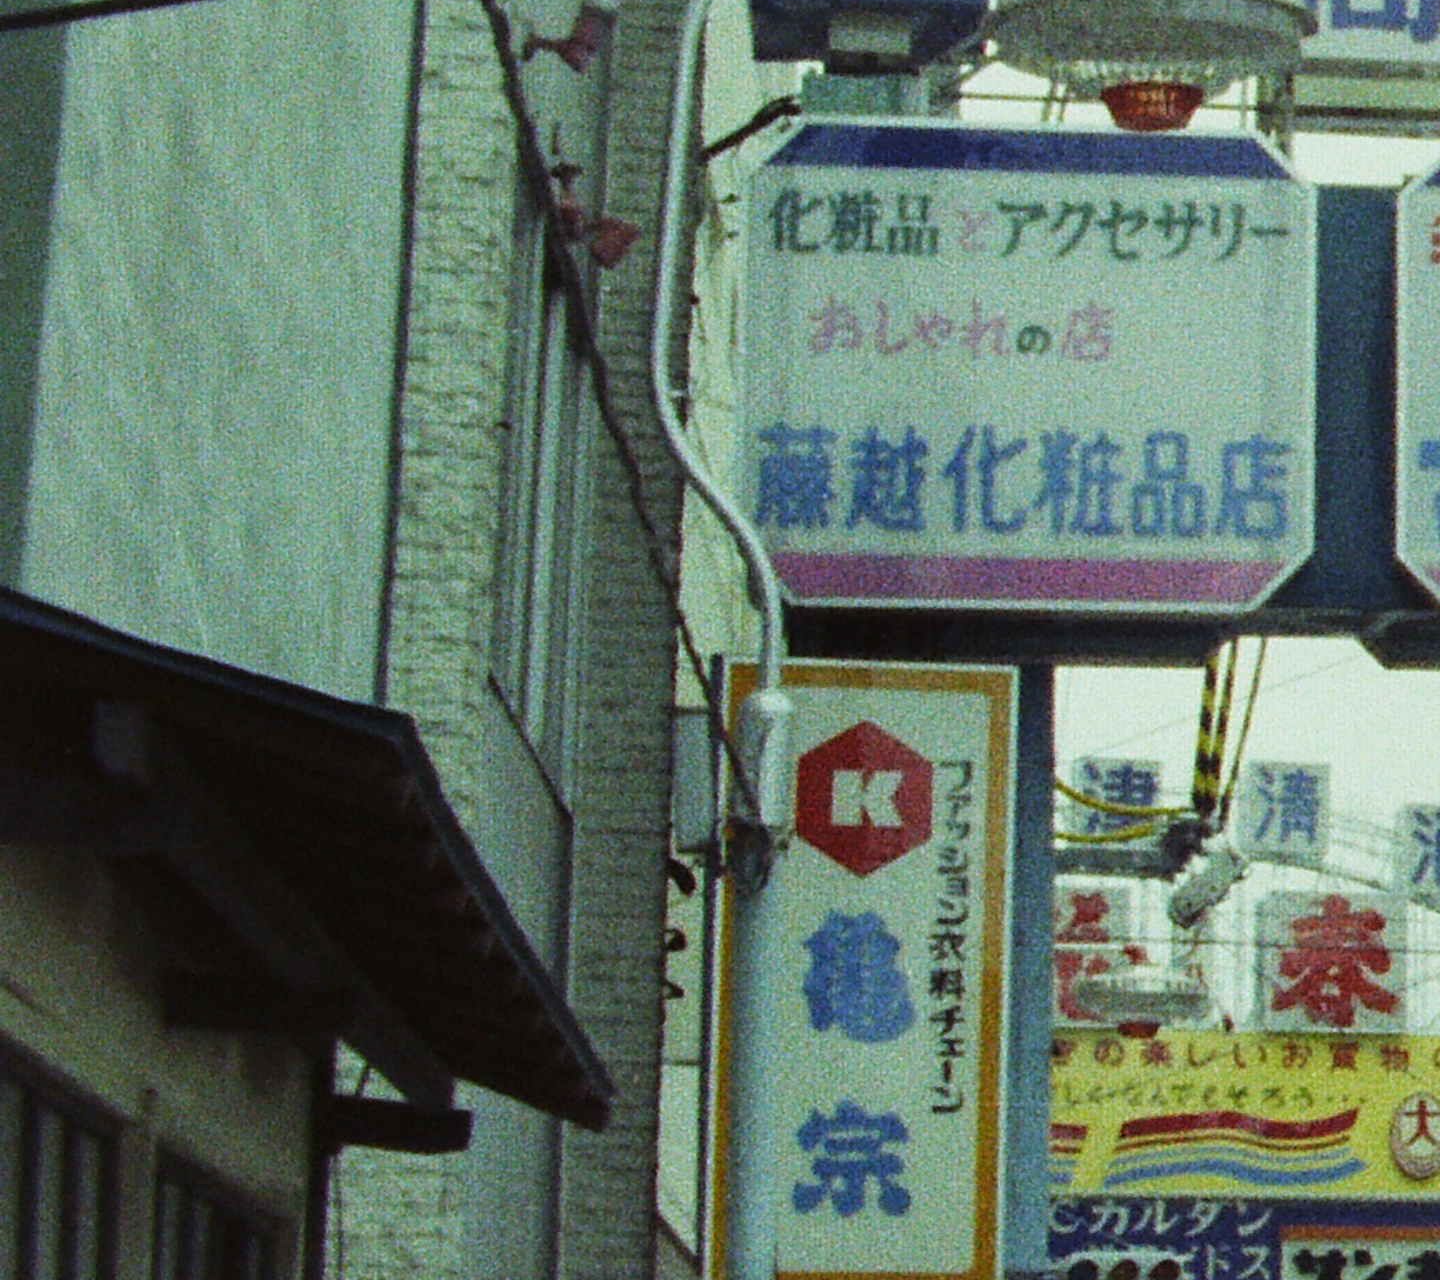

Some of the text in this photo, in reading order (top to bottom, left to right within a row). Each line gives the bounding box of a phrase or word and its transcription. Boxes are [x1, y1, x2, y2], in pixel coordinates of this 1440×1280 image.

[808, 295, 1113, 362] おしゃれの店
[831, 770, 903, 828] K
